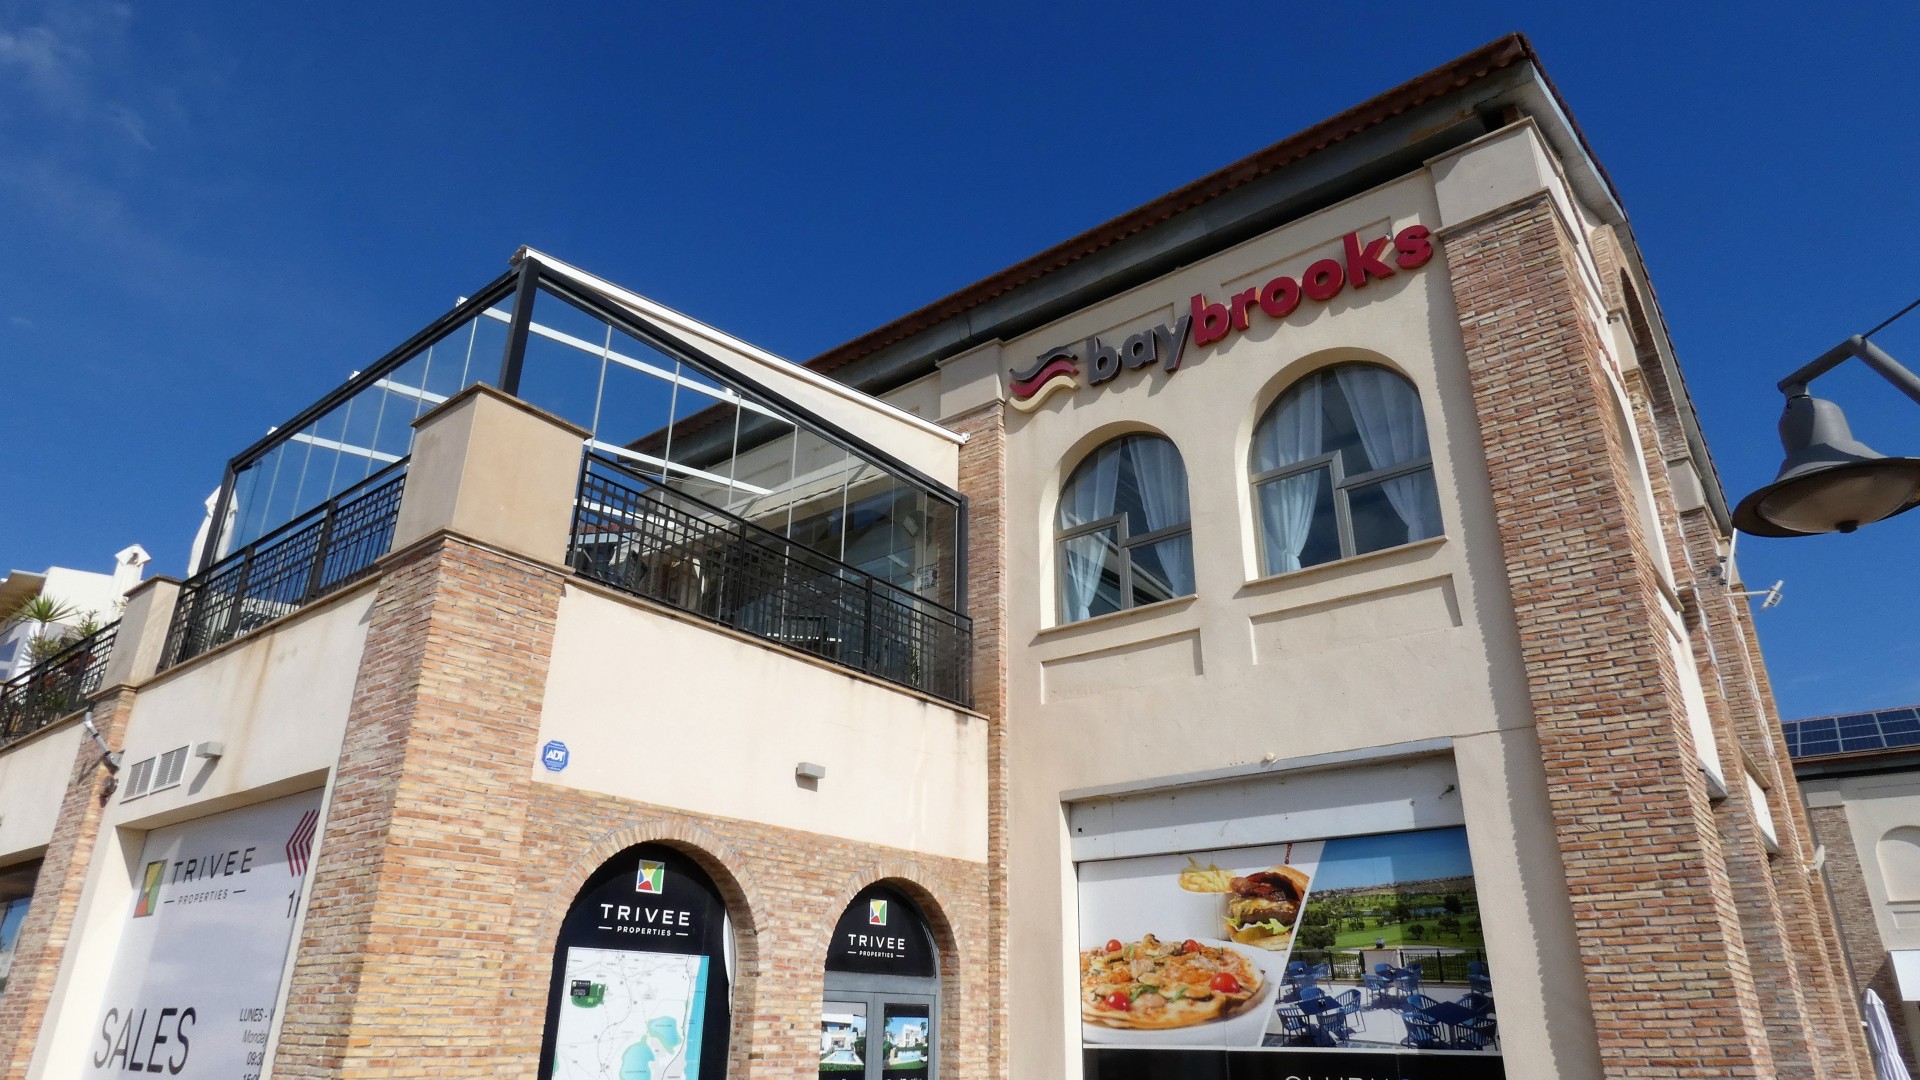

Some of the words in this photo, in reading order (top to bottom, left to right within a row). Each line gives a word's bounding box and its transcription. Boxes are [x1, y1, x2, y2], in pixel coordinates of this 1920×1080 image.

[1087, 225, 1434, 387] baybrooks
[546, 749, 566, 762] ADT
[172, 847, 256, 885] TRIVEE
[178, 889, 228, 904] PROPERTIES
[600, 903, 691, 926] TRIVEE
[616, 925, 672, 937] PROPERTIES
[848, 934, 906, 950] TRIVEE
[859, 950, 894, 958] PROPERTIES
[239, 1008, 264, 1022] LUNES
[94, 1006, 197, 1075] SALES
